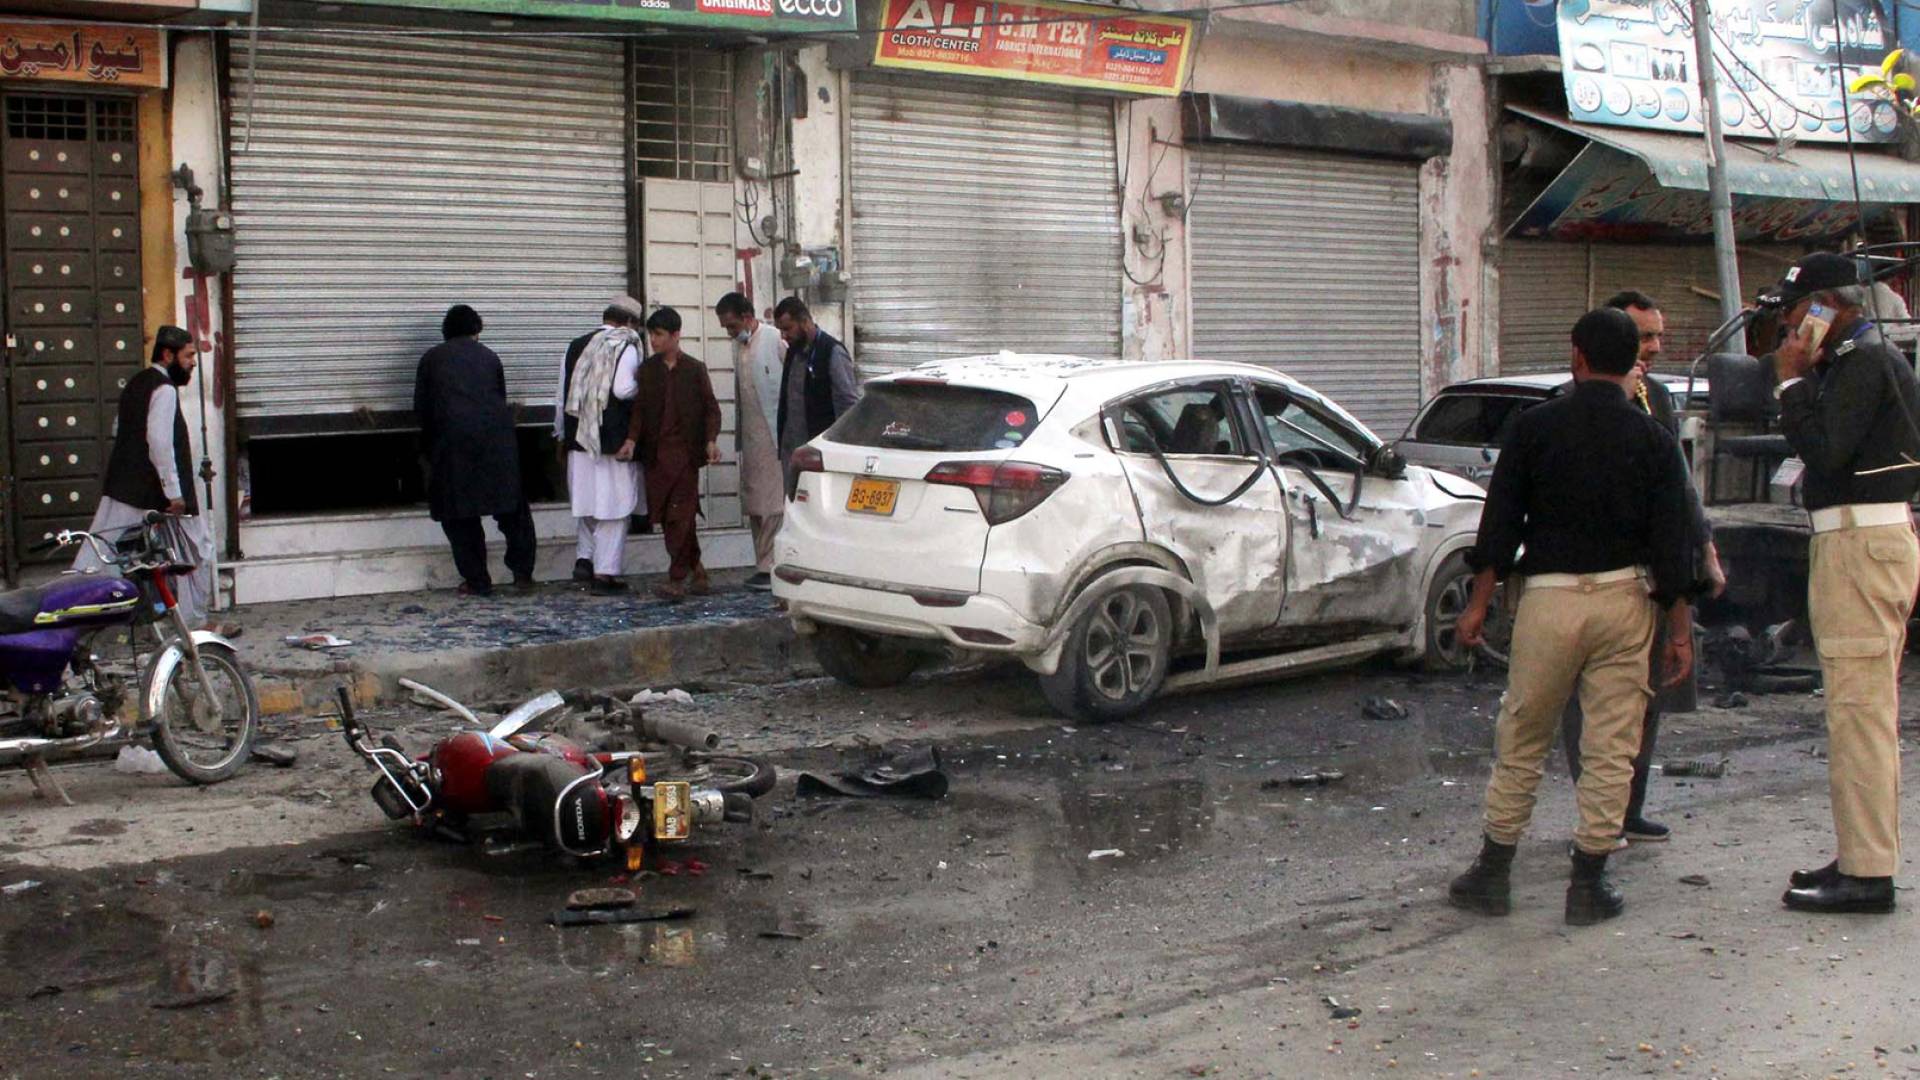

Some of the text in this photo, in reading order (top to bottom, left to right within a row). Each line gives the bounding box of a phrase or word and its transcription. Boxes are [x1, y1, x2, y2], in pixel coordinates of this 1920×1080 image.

[893, 0, 985, 38] ALI
[1047, 20, 1089, 45] TEX
[0, 30, 144, 79] نیو امین
[891, 33, 980, 52] CLOTH CENTER
[575, 797, 586, 841] HONDA
